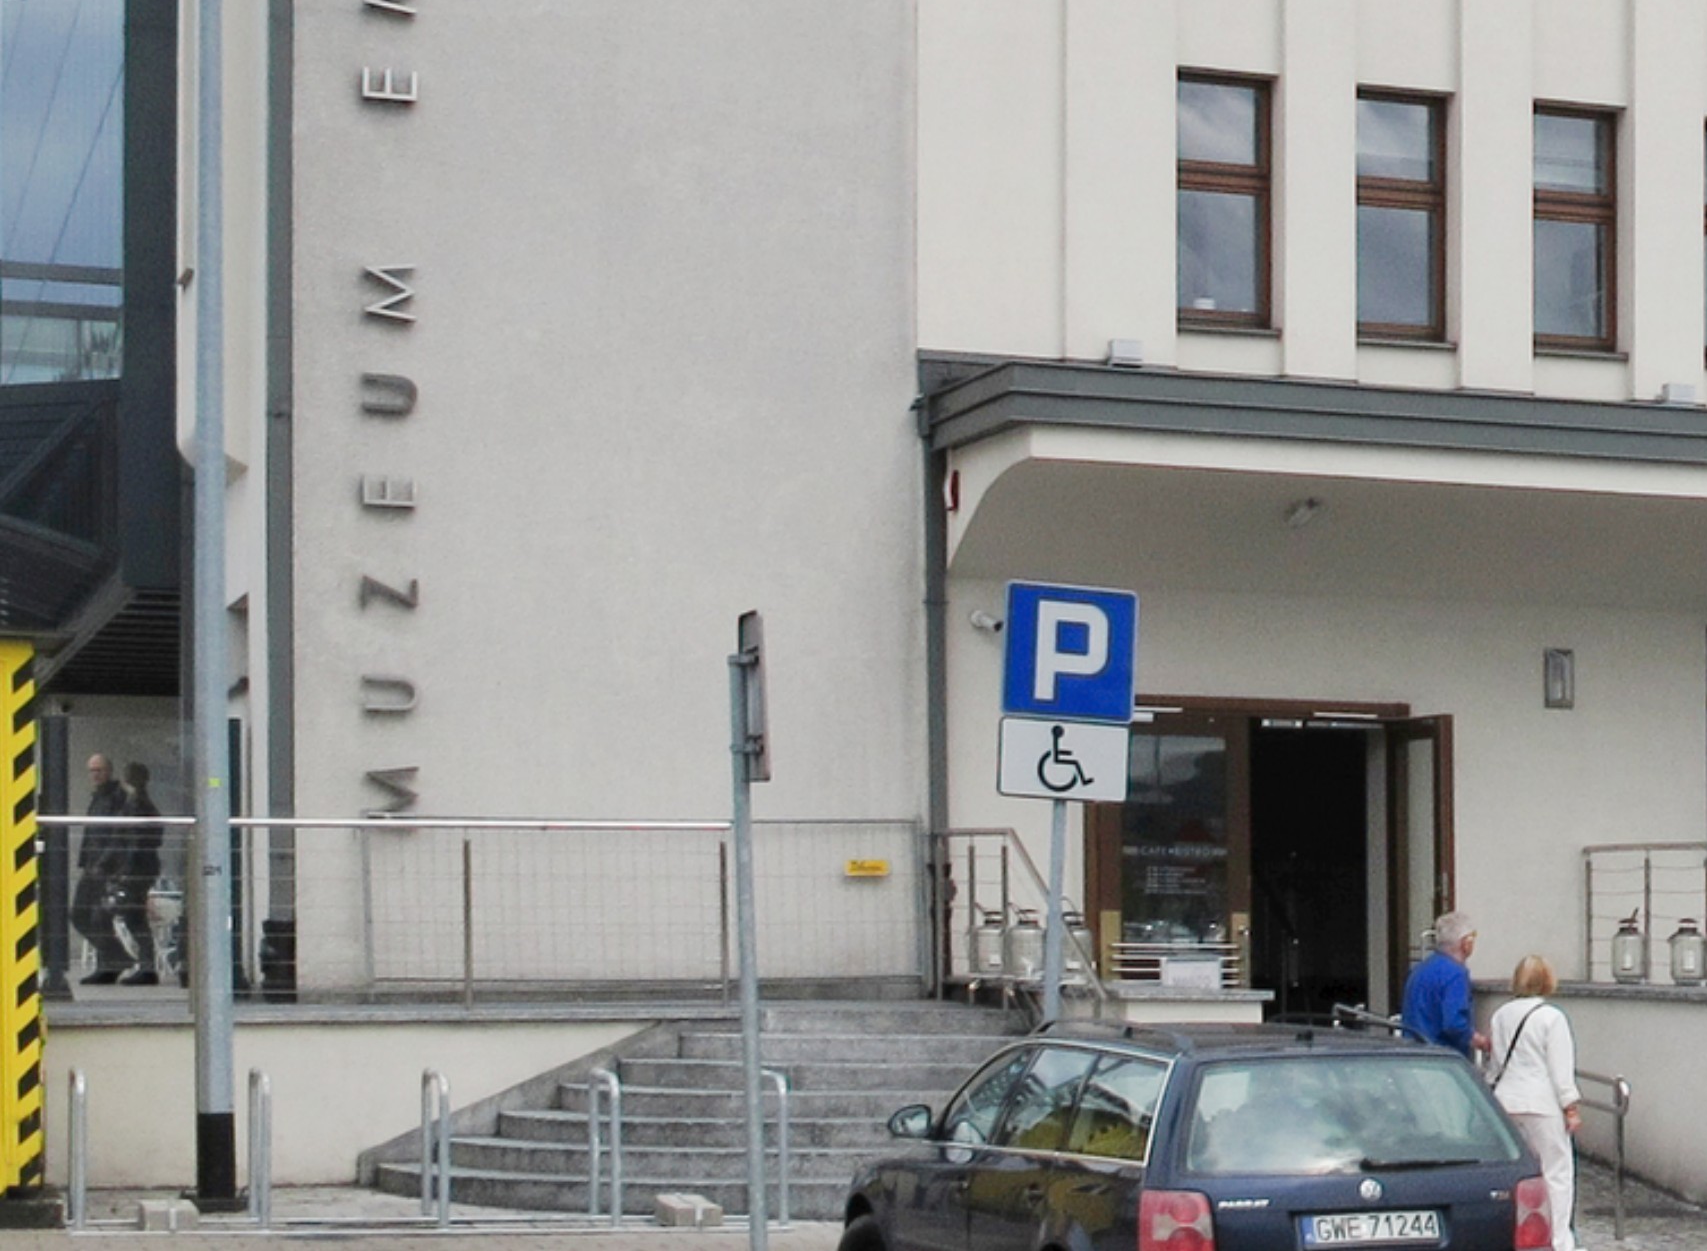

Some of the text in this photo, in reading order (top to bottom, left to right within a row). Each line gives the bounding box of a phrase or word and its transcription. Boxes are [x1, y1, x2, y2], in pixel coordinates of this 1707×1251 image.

[361, 262, 420, 832] MUZEUM
[1034, 600, 1108, 700] P
[1316, 1213, 1437, 1242] GWE 71244
